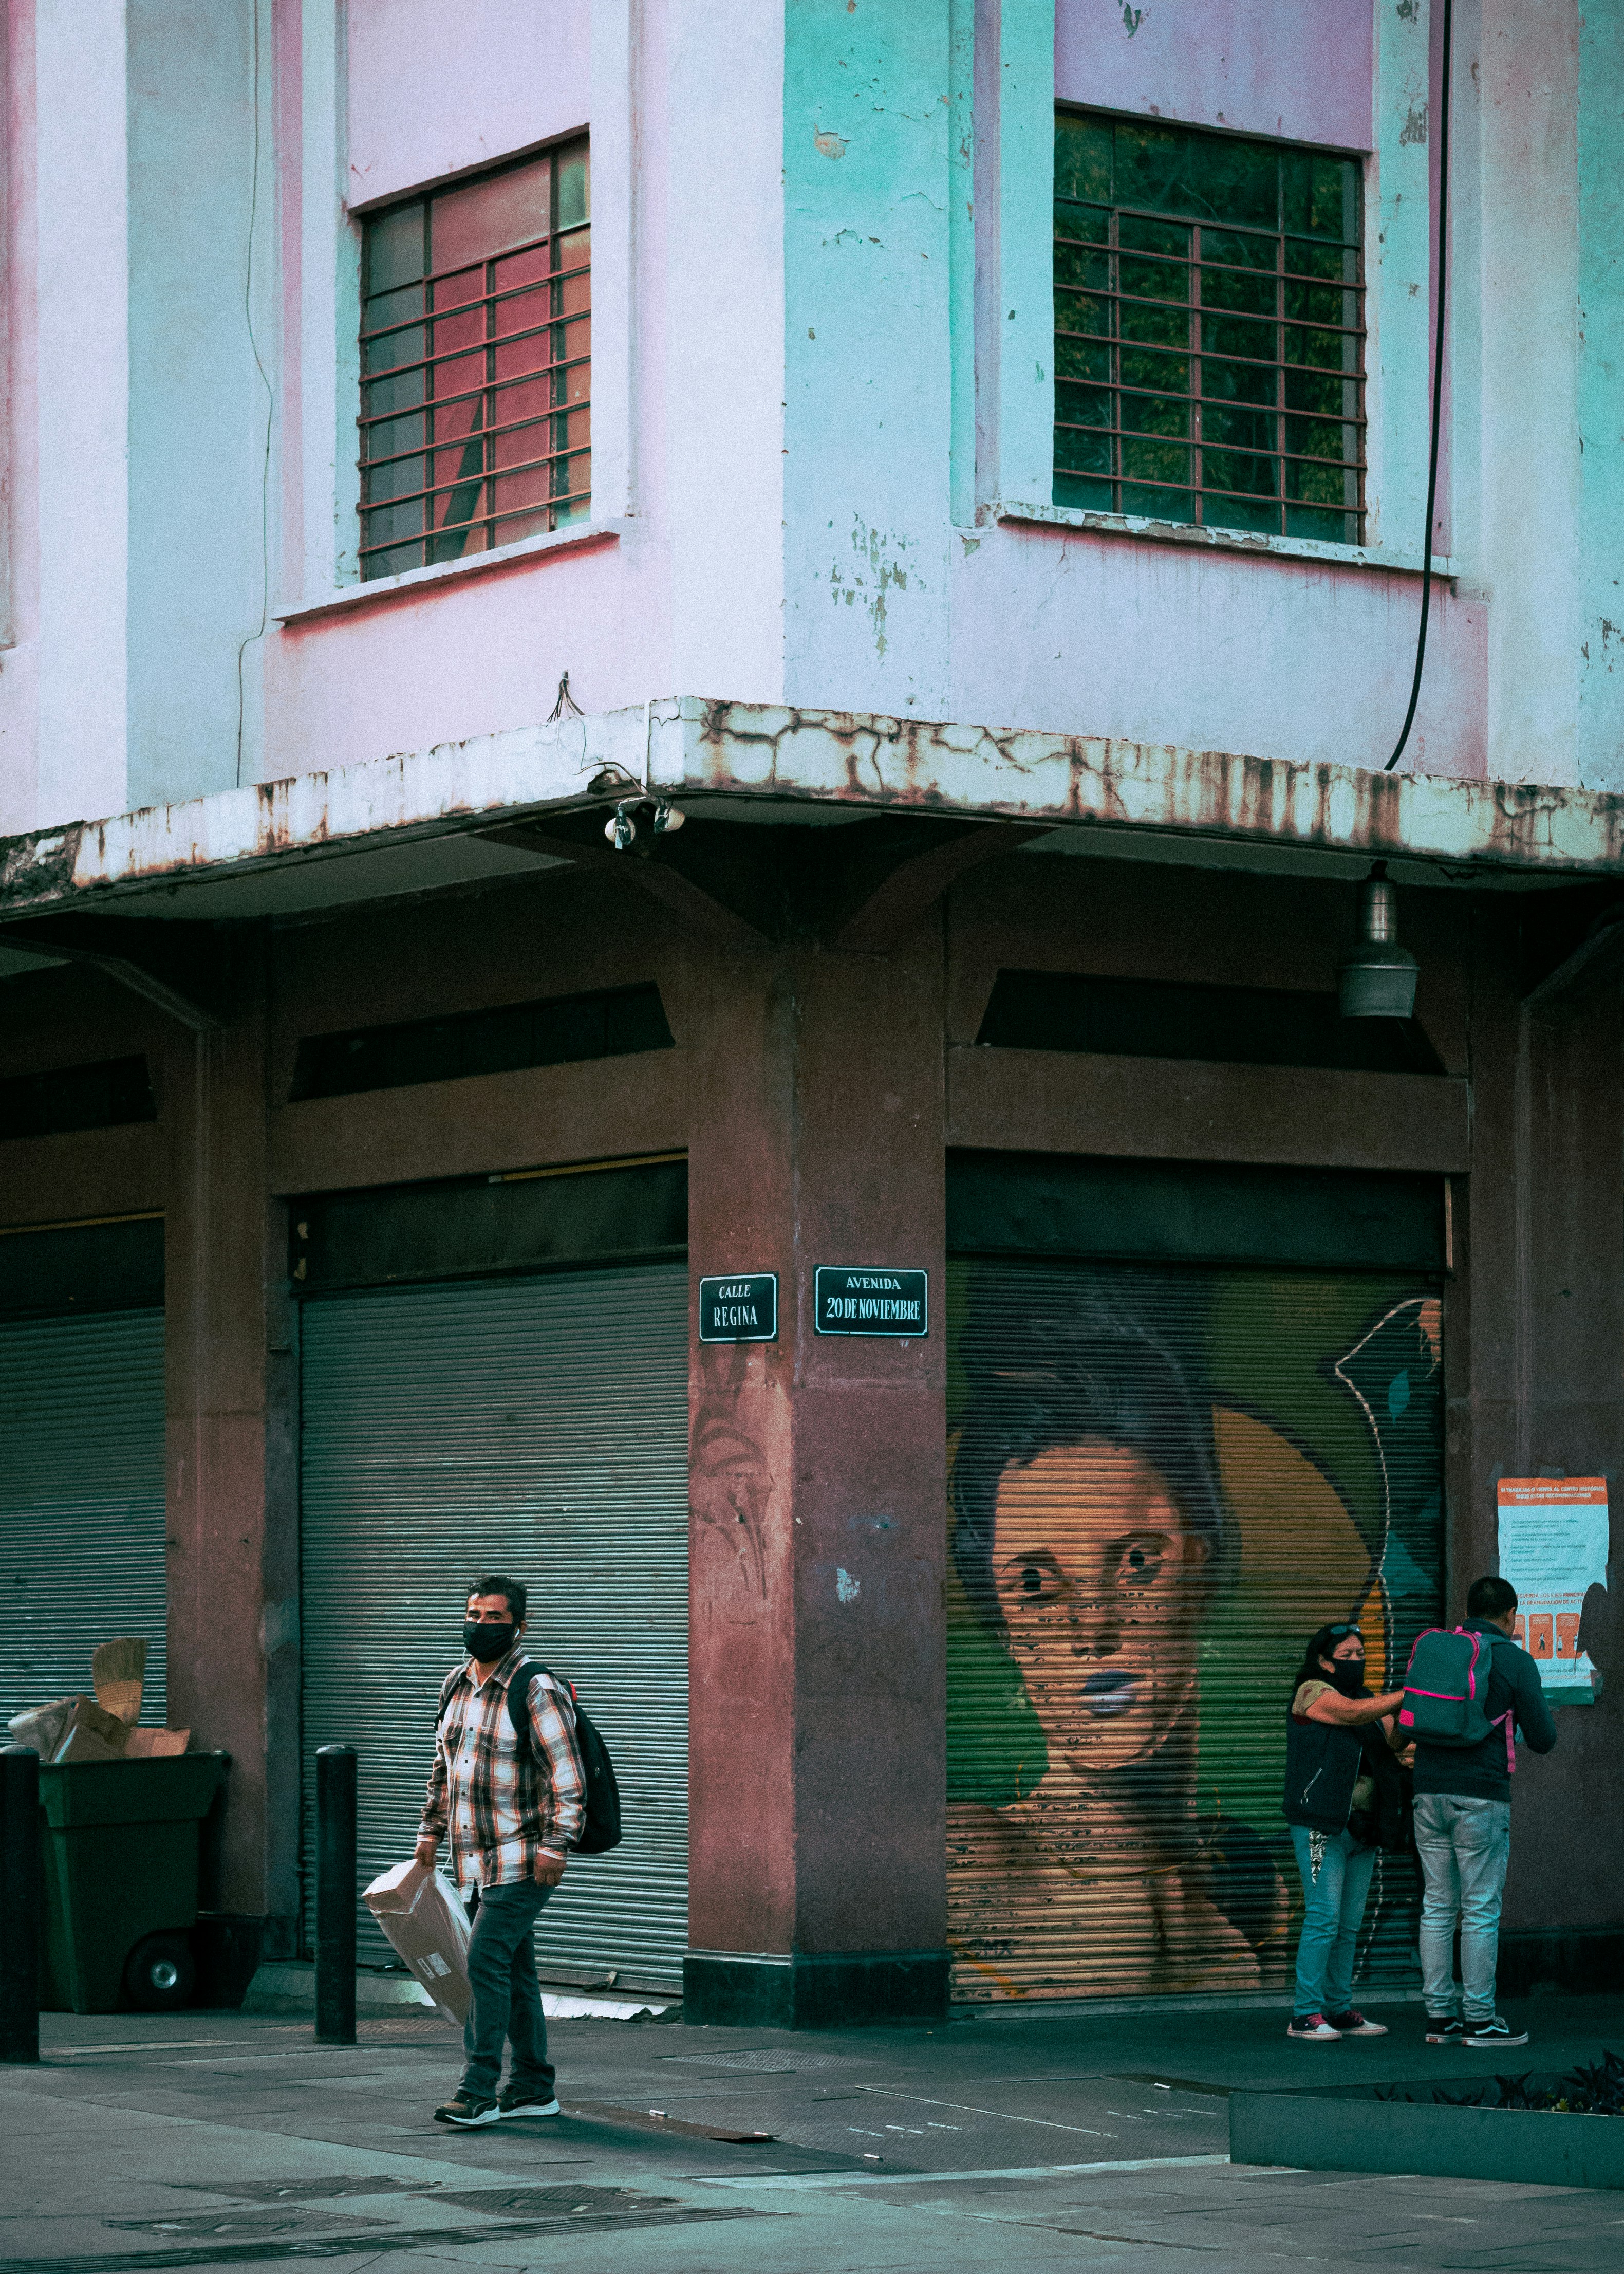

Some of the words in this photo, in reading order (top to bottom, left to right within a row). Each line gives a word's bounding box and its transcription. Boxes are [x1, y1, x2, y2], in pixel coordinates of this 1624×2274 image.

[719, 1284, 751, 1299] CALLE
[846, 1277, 901, 1290] AVENIDA
[714, 1305, 758, 1327] REGINA
[826, 1297, 843, 1319] 20
[844, 1298, 857, 1319] DE
[858, 1298, 921, 1320] NOVIEMBRE
